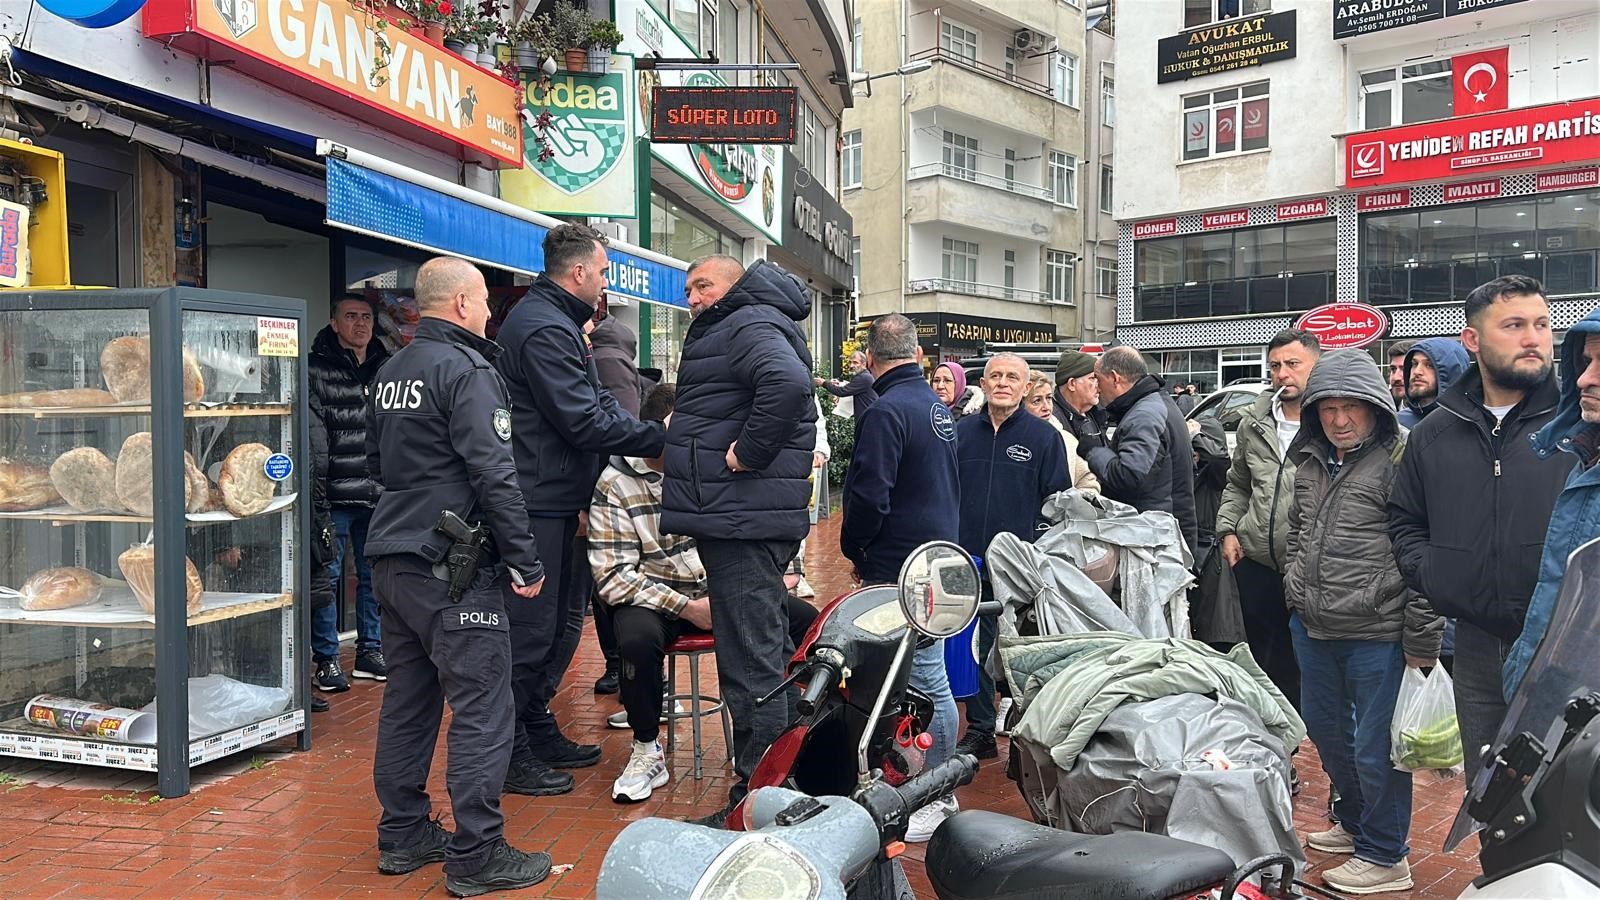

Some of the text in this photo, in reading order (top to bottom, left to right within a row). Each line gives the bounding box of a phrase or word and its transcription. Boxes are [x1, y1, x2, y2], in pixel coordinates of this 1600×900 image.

[1336, 0, 1423, 19] ARABUL
[1386, 3, 1428, 18] ERDOĞAN
[1457, 0, 1503, 10] HUK
[1188, 18, 1266, 45] AVUKAT
[1358, 14, 1417, 33] 0505 700 71 08
[1176, 32, 1275, 60] Vatan Oğuzhan ERBUL
[268, 0, 461, 130] GANYAN
[1163, 40, 1289, 74] HUKUK & DANIŞMANLIK
[1209, 64, 1225, 73] 0541
[667, 105, 779, 125] SÜPER LOTO
[1468, 125, 1528, 151] REFAH
[1448, 180, 1496, 197] MANTI
[1538, 171, 1596, 187] HAMBURGER
[1365, 192, 1402, 207] FIRIN
[794, 195, 822, 243] OTEL
[1205, 212, 1246, 225] YEMEK
[1279, 202, 1324, 217] IZGARA
[1136, 222, 1174, 236] DÖNER
[619, 259, 650, 295] BÜFE
[946, 322, 992, 342] TASARIM
[1003, 328, 1053, 343] UYGULAMA
[1304, 315, 1375, 332] Sebat
